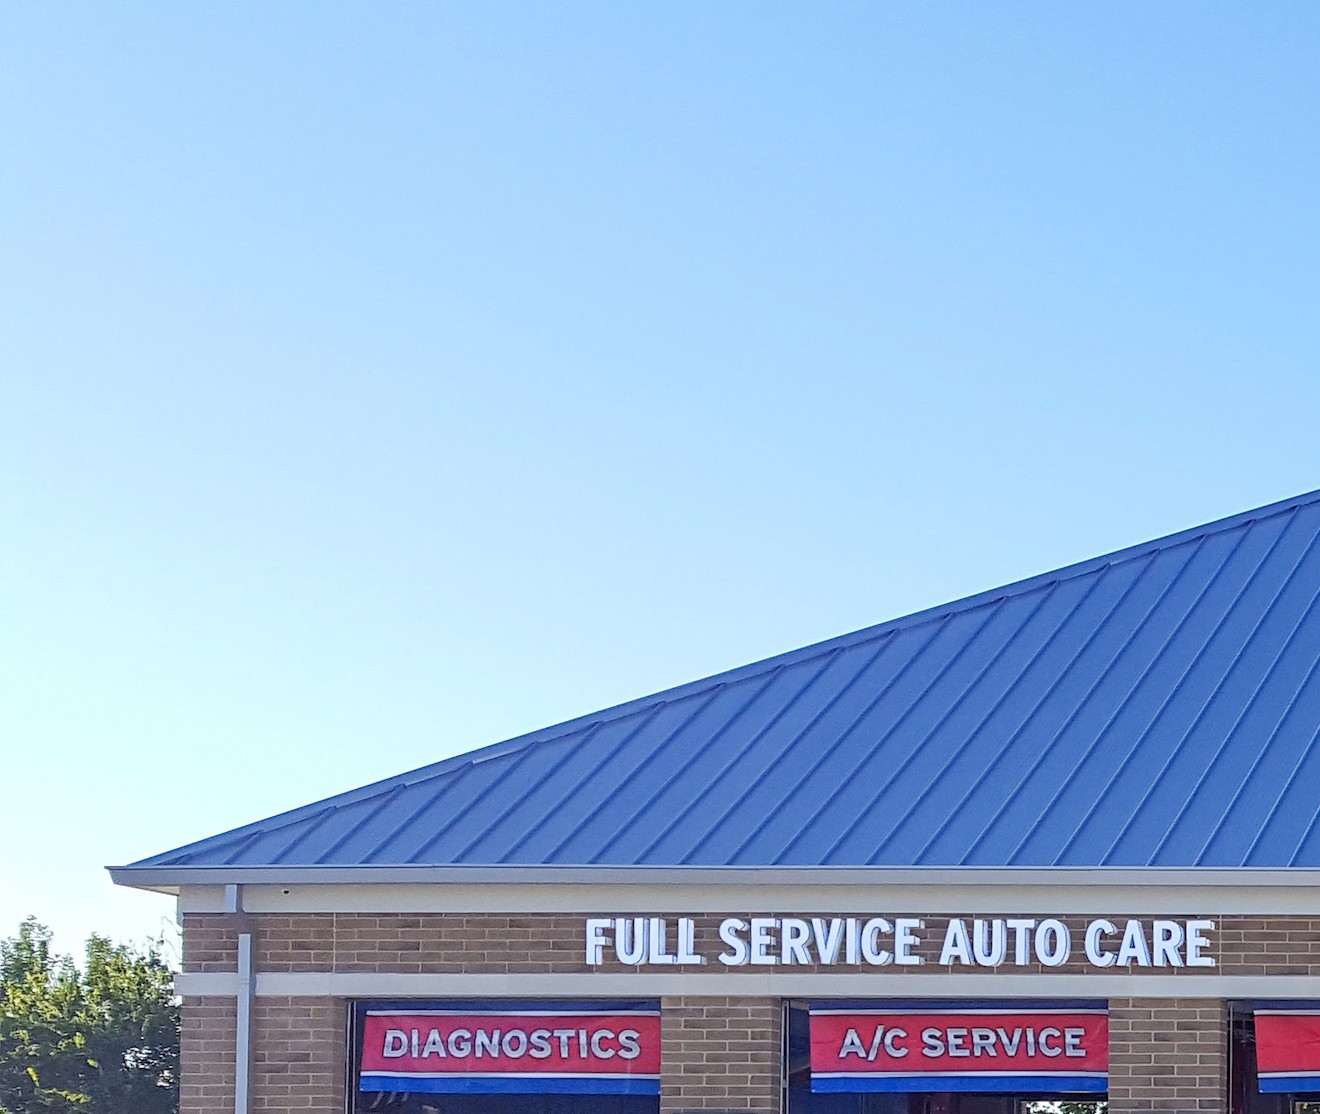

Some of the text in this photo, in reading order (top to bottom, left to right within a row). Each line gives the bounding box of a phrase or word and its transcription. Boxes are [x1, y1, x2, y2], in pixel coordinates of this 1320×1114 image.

[585, 917, 1217, 968] FULL SERVICE AUTO CARE
[382, 1028, 642, 1060] DIAGNOSTICS
[838, 1024, 1087, 1062] A/C SERVICE
